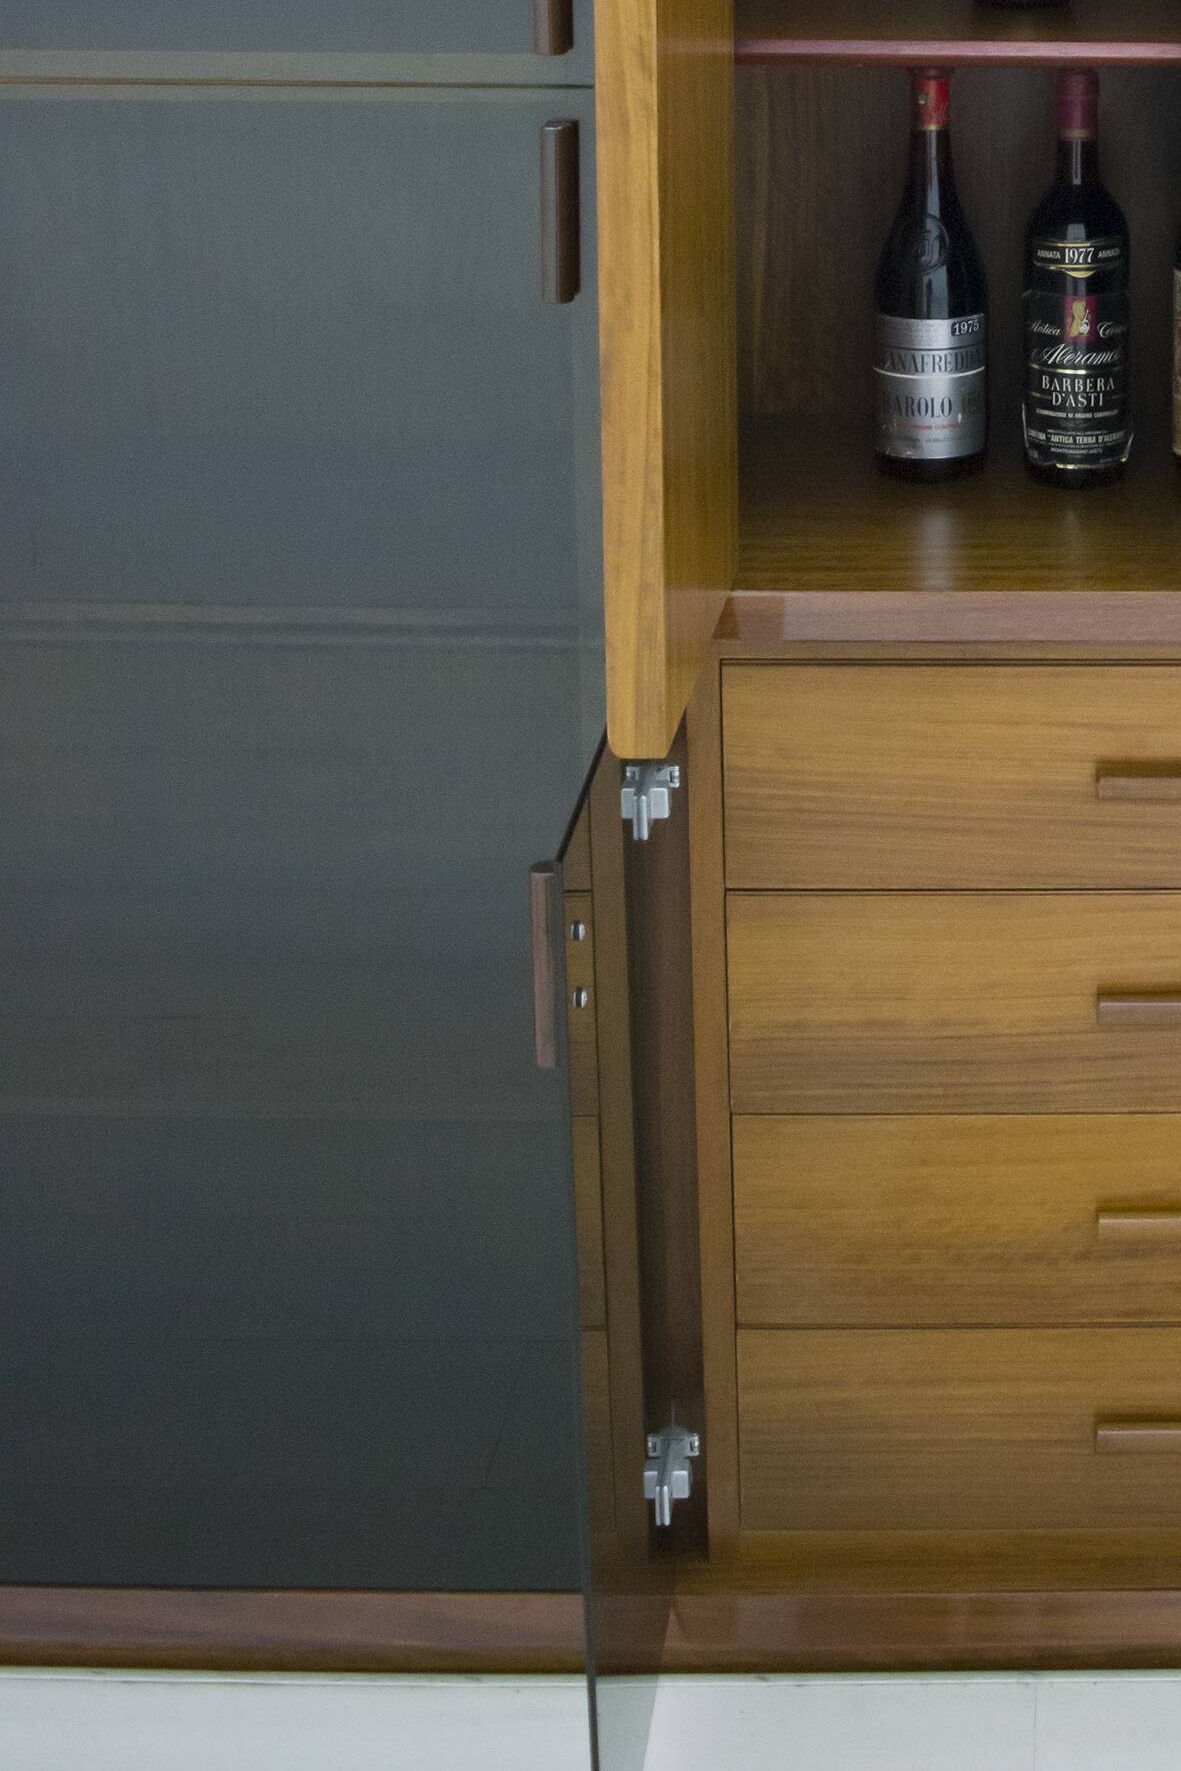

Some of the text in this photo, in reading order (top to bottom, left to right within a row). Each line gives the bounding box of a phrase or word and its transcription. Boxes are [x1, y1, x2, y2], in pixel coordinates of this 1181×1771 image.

[1064, 247, 1095, 264] 1977
[953, 319, 980, 335] 1975
[1041, 374, 1115, 393] BARBERA
[884, 395, 954, 418] AROLO
[1052, 393, 1103, 407] D'ASTI
